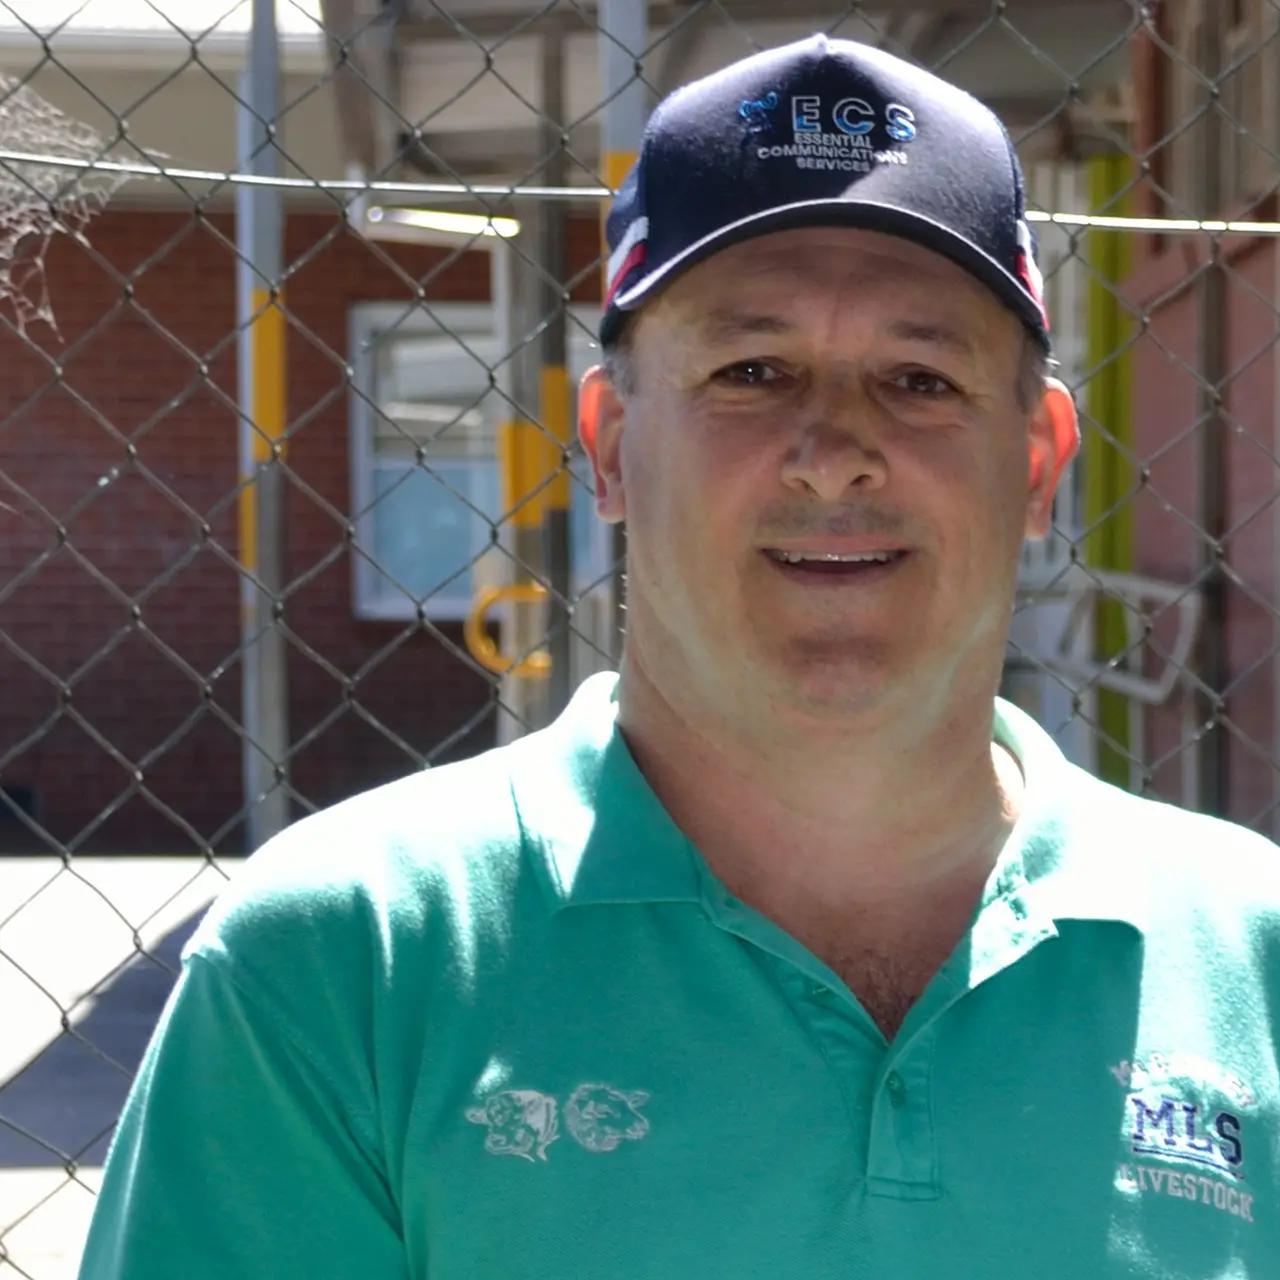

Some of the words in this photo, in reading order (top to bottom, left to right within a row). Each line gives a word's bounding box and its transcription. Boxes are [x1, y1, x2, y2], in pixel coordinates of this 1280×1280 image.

[791, 95, 916, 141] ECS
[794, 132, 873, 149] ESSENTIAL
[795, 157, 870, 172] SERVICES
[1131, 1098, 1243, 1165] MLS
